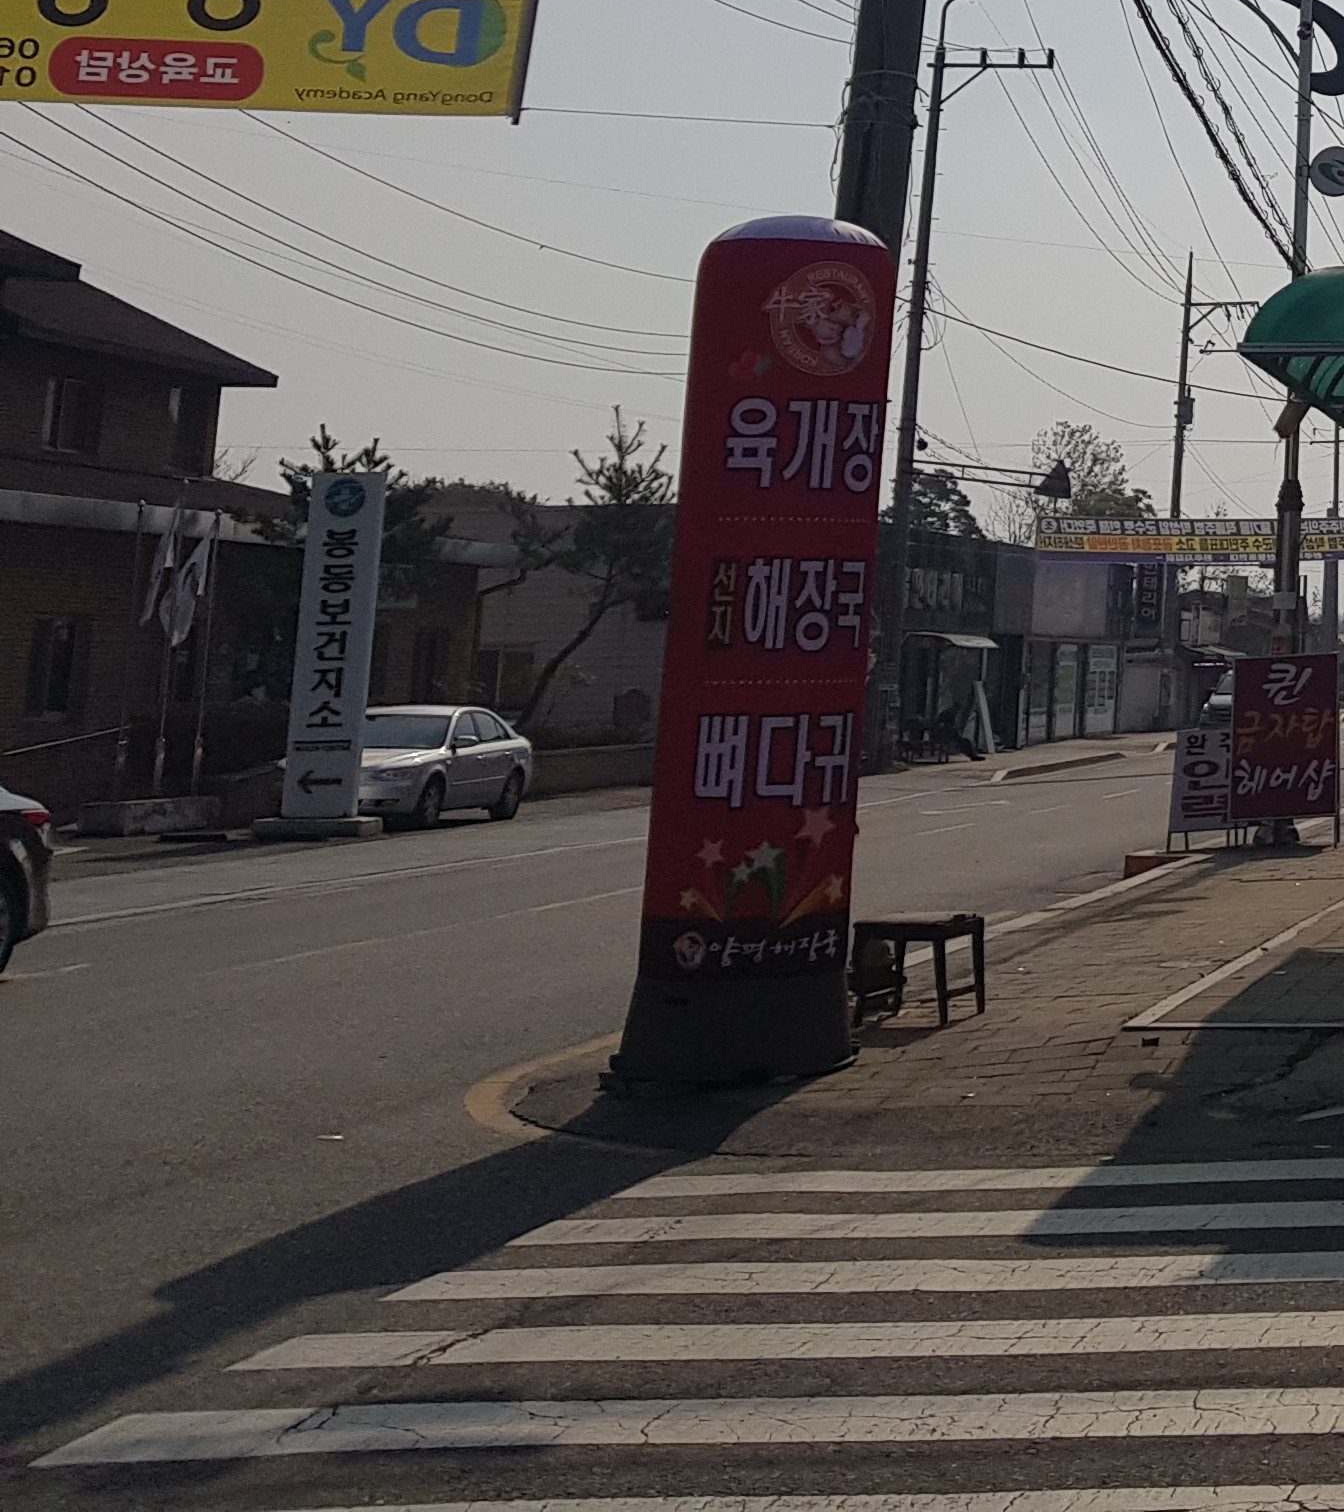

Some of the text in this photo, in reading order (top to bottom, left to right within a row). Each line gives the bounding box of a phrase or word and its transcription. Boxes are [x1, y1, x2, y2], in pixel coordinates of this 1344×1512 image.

[725, 396, 880, 493] 육개장
[305, 528, 359, 729] 봉동보건지소
[708, 562, 738, 646] 선지
[744, 557, 867, 652] 해장국
[1262, 662, 1313, 706] 퀸
[693, 711, 855, 810] 뼈다귀
[1234, 758, 1337, 802] 헤어샵
